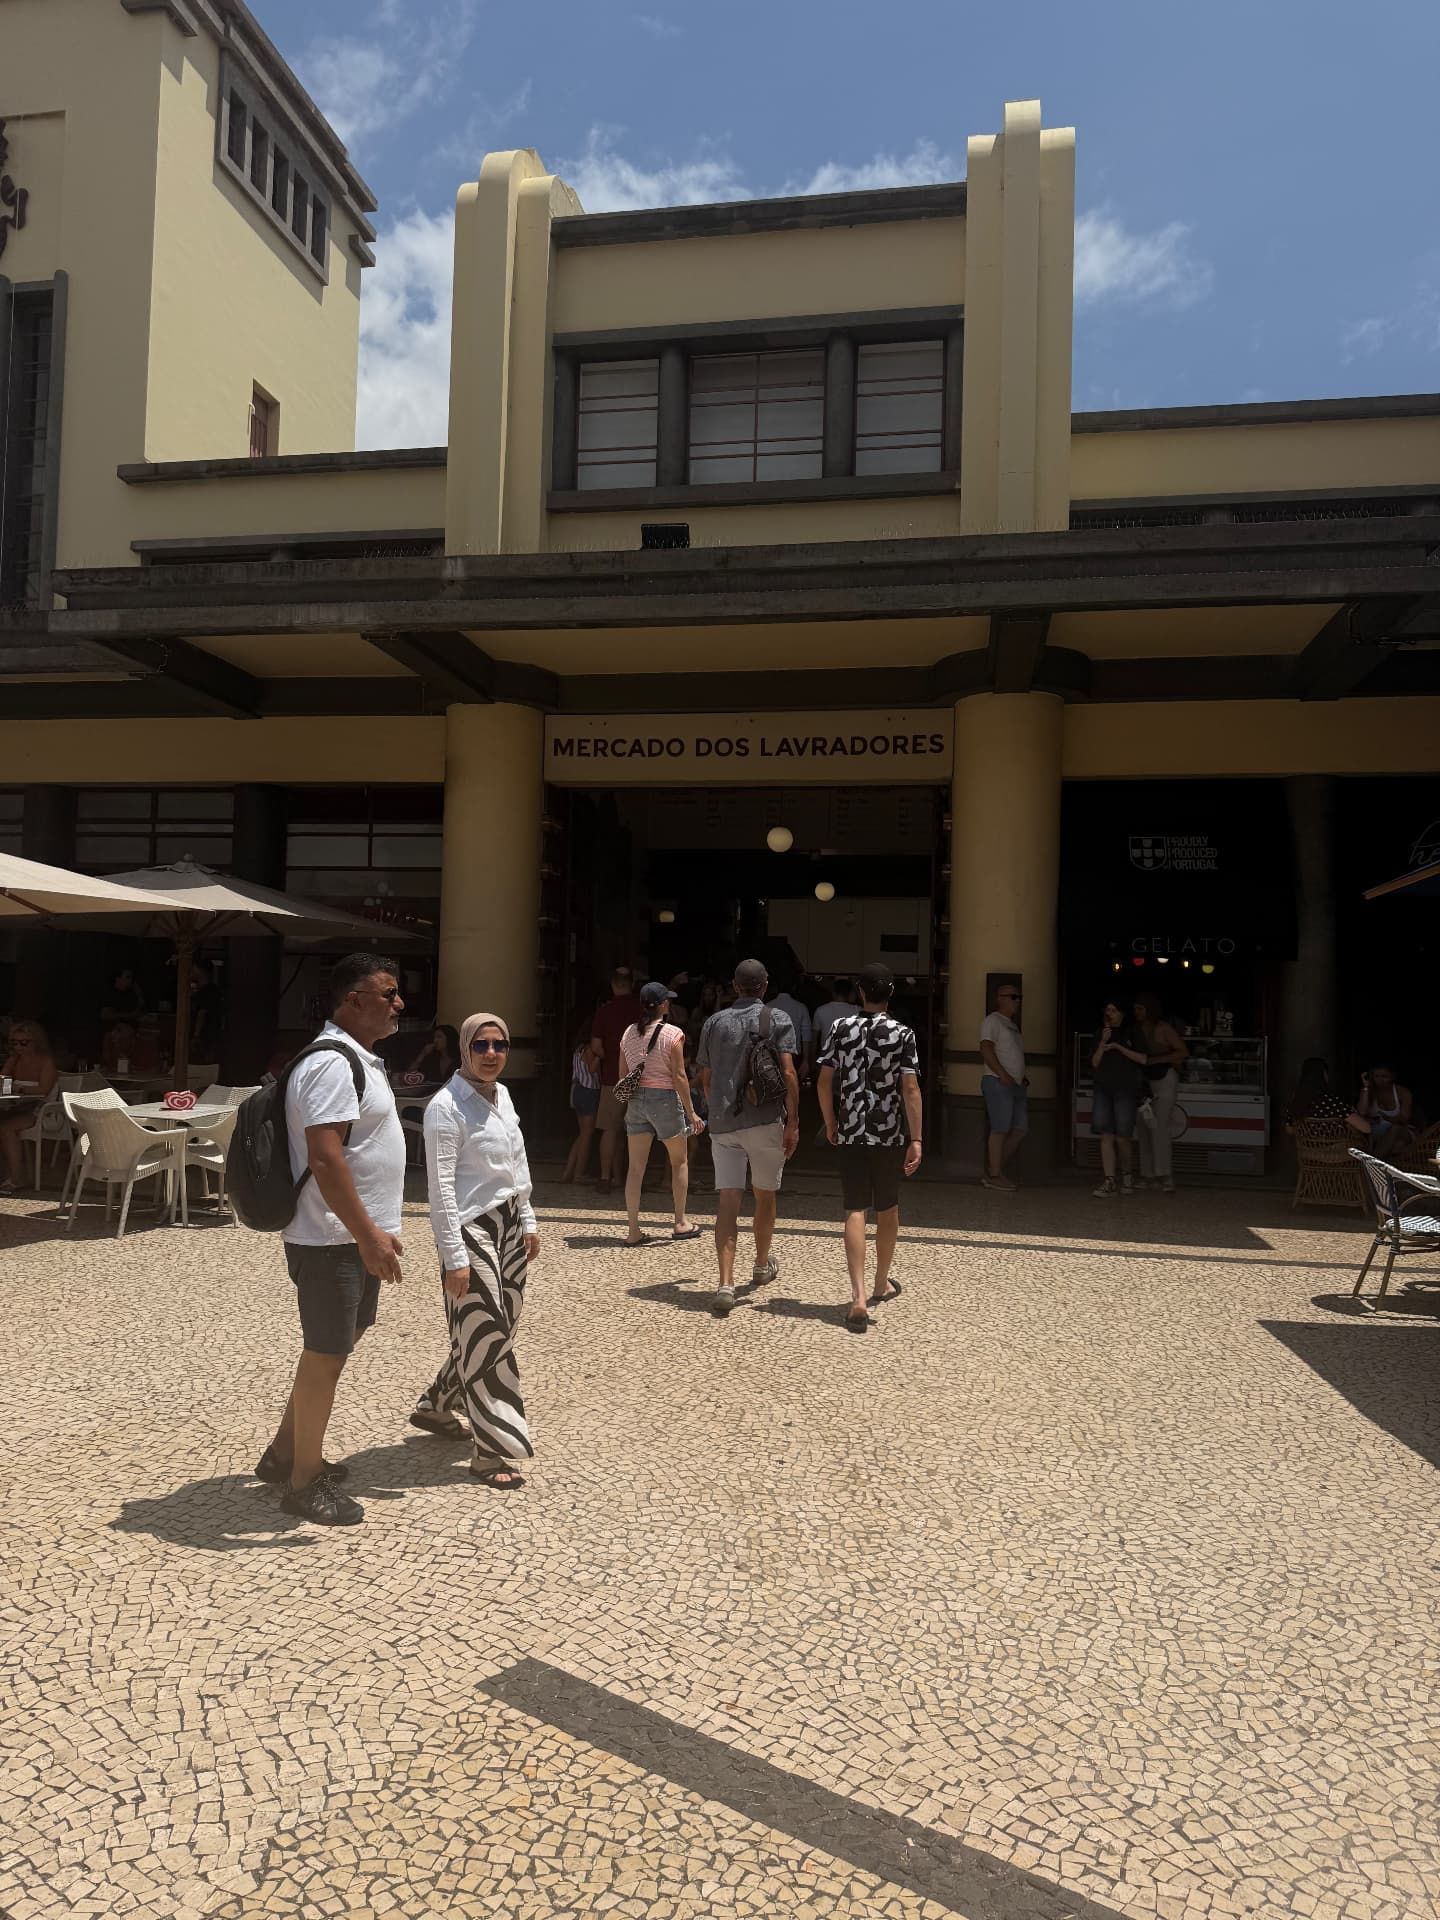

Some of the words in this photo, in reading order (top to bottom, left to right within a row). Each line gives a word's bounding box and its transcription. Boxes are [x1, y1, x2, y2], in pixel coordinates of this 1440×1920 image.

[553, 738, 685, 758] MERCADO
[696, 737, 750, 757] DOS
[760, 733, 945, 757] LAVRADORES
[1168, 848, 1217, 858] PRODUCED
[1168, 859, 1219, 870] PORTUGAL
[1131, 937, 1236, 954] GELATO
